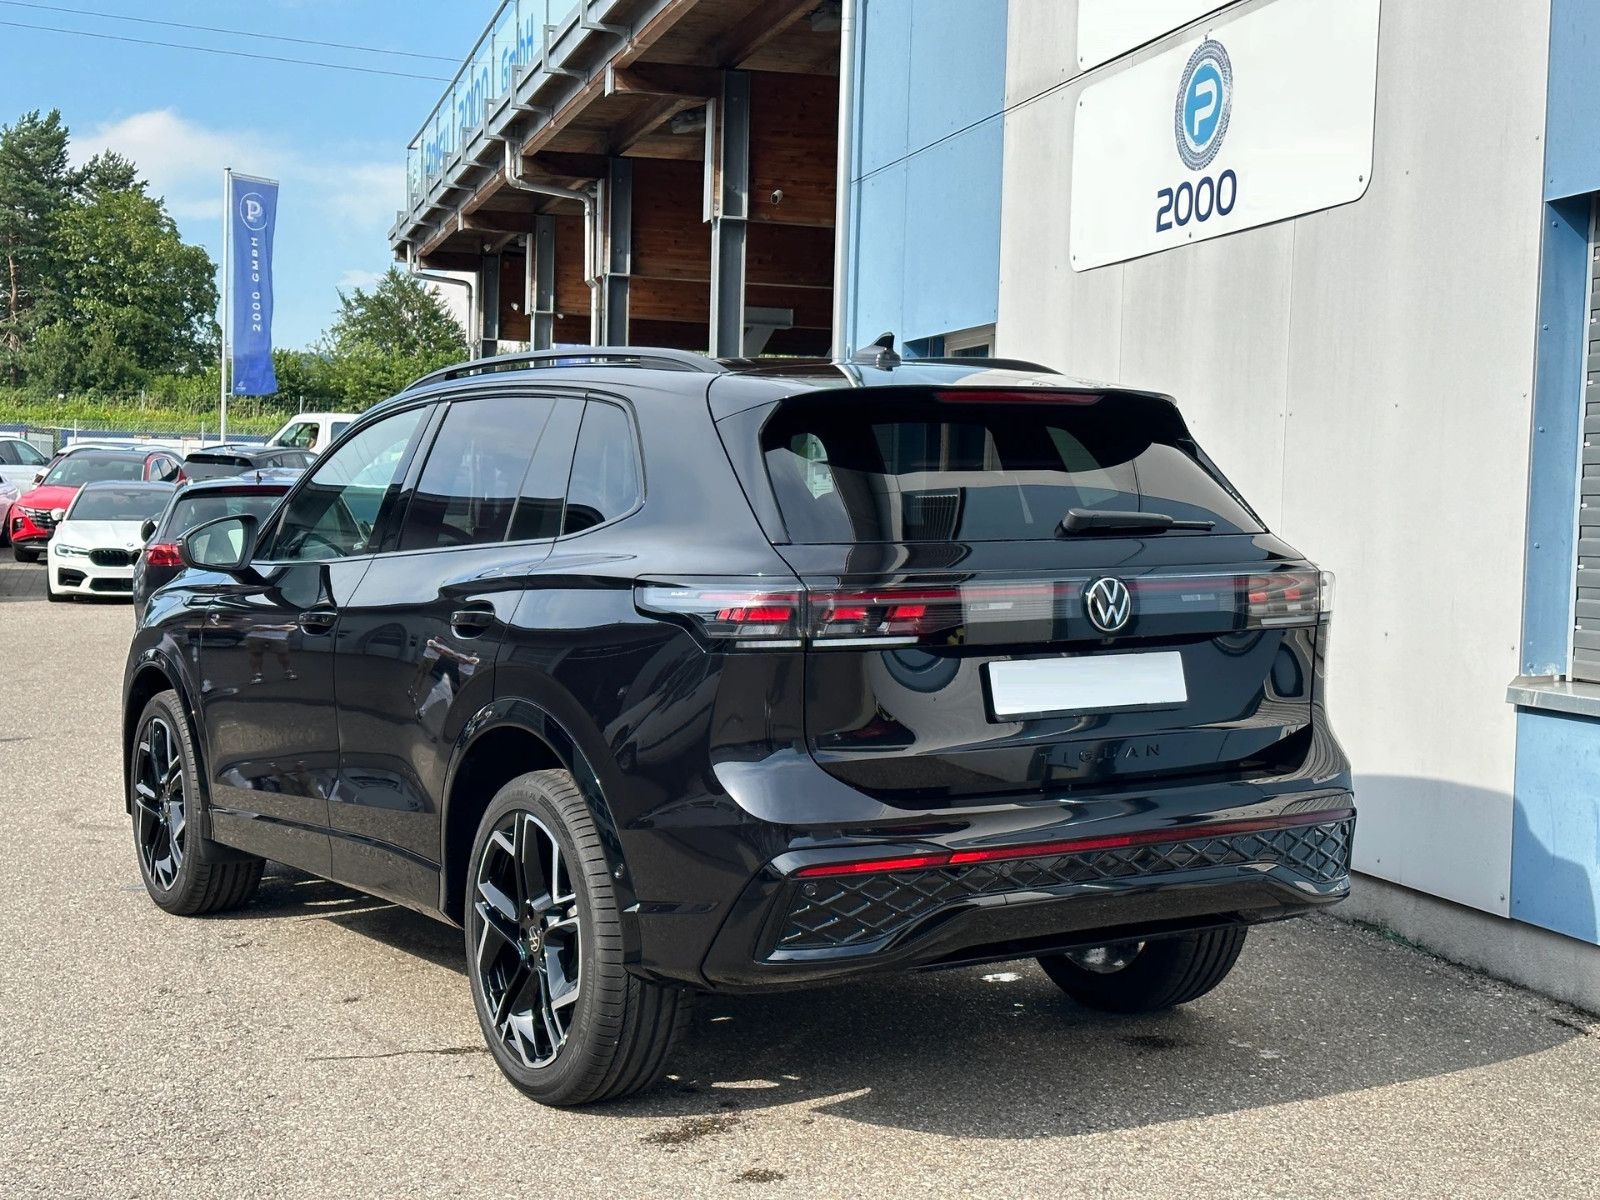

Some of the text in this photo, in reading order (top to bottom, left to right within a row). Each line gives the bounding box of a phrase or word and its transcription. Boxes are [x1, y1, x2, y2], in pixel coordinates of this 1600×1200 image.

[1156, 169, 1237, 233] 2000
[251, 237, 261, 332] 2000 GMBH
